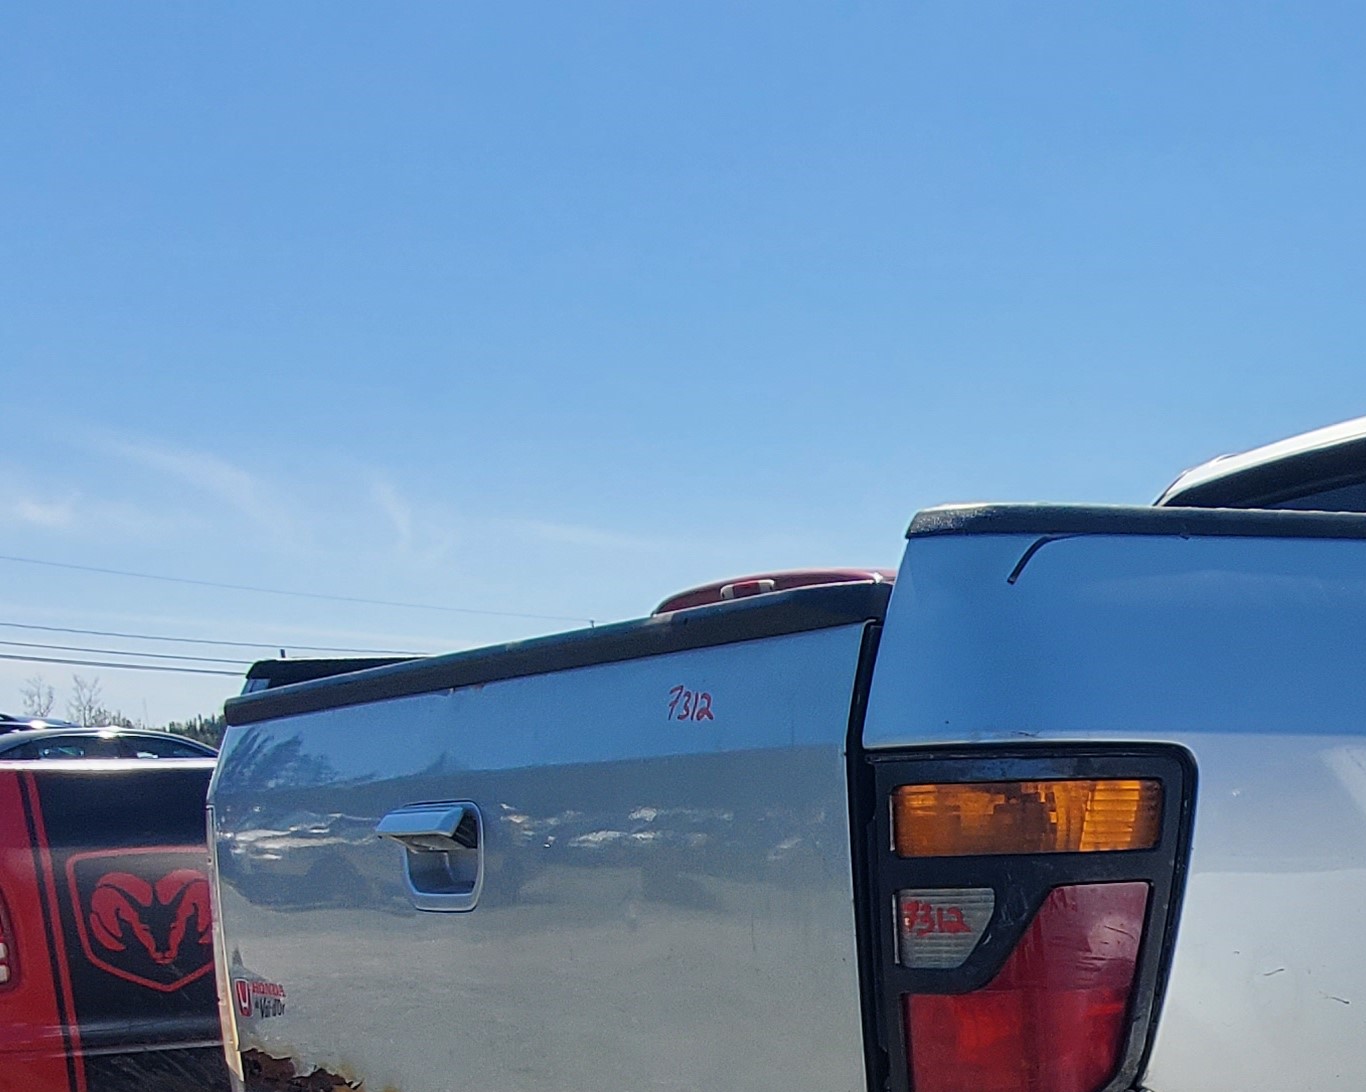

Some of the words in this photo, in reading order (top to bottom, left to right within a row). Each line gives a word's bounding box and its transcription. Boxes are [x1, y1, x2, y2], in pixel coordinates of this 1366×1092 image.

[668, 684, 714, 721] 7312
[902, 900, 971, 937] 7312
[251, 981, 286, 998] HONDA
